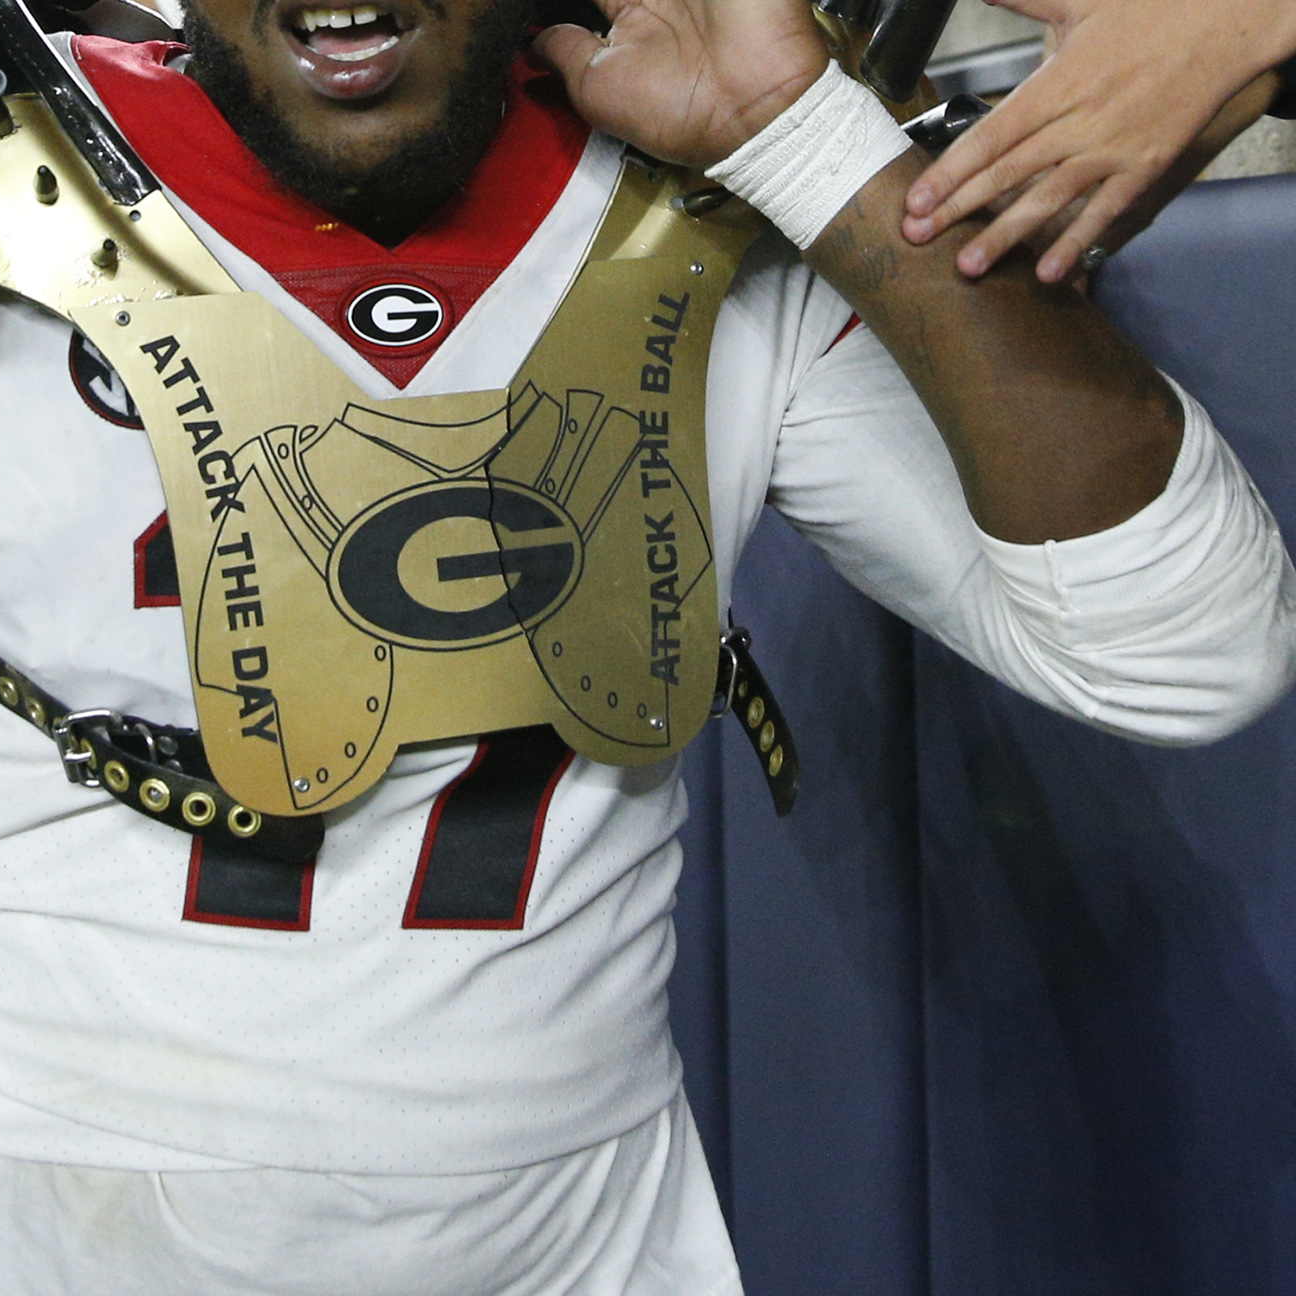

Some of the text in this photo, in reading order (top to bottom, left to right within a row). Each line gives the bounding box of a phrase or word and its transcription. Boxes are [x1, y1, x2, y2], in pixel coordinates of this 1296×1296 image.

[349, 285, 440, 344] G
[140, 335, 280, 744] ATTACK THE DAY
[337, 486, 576, 642] G
[639, 292, 691, 685] ATTACK THE BALL
